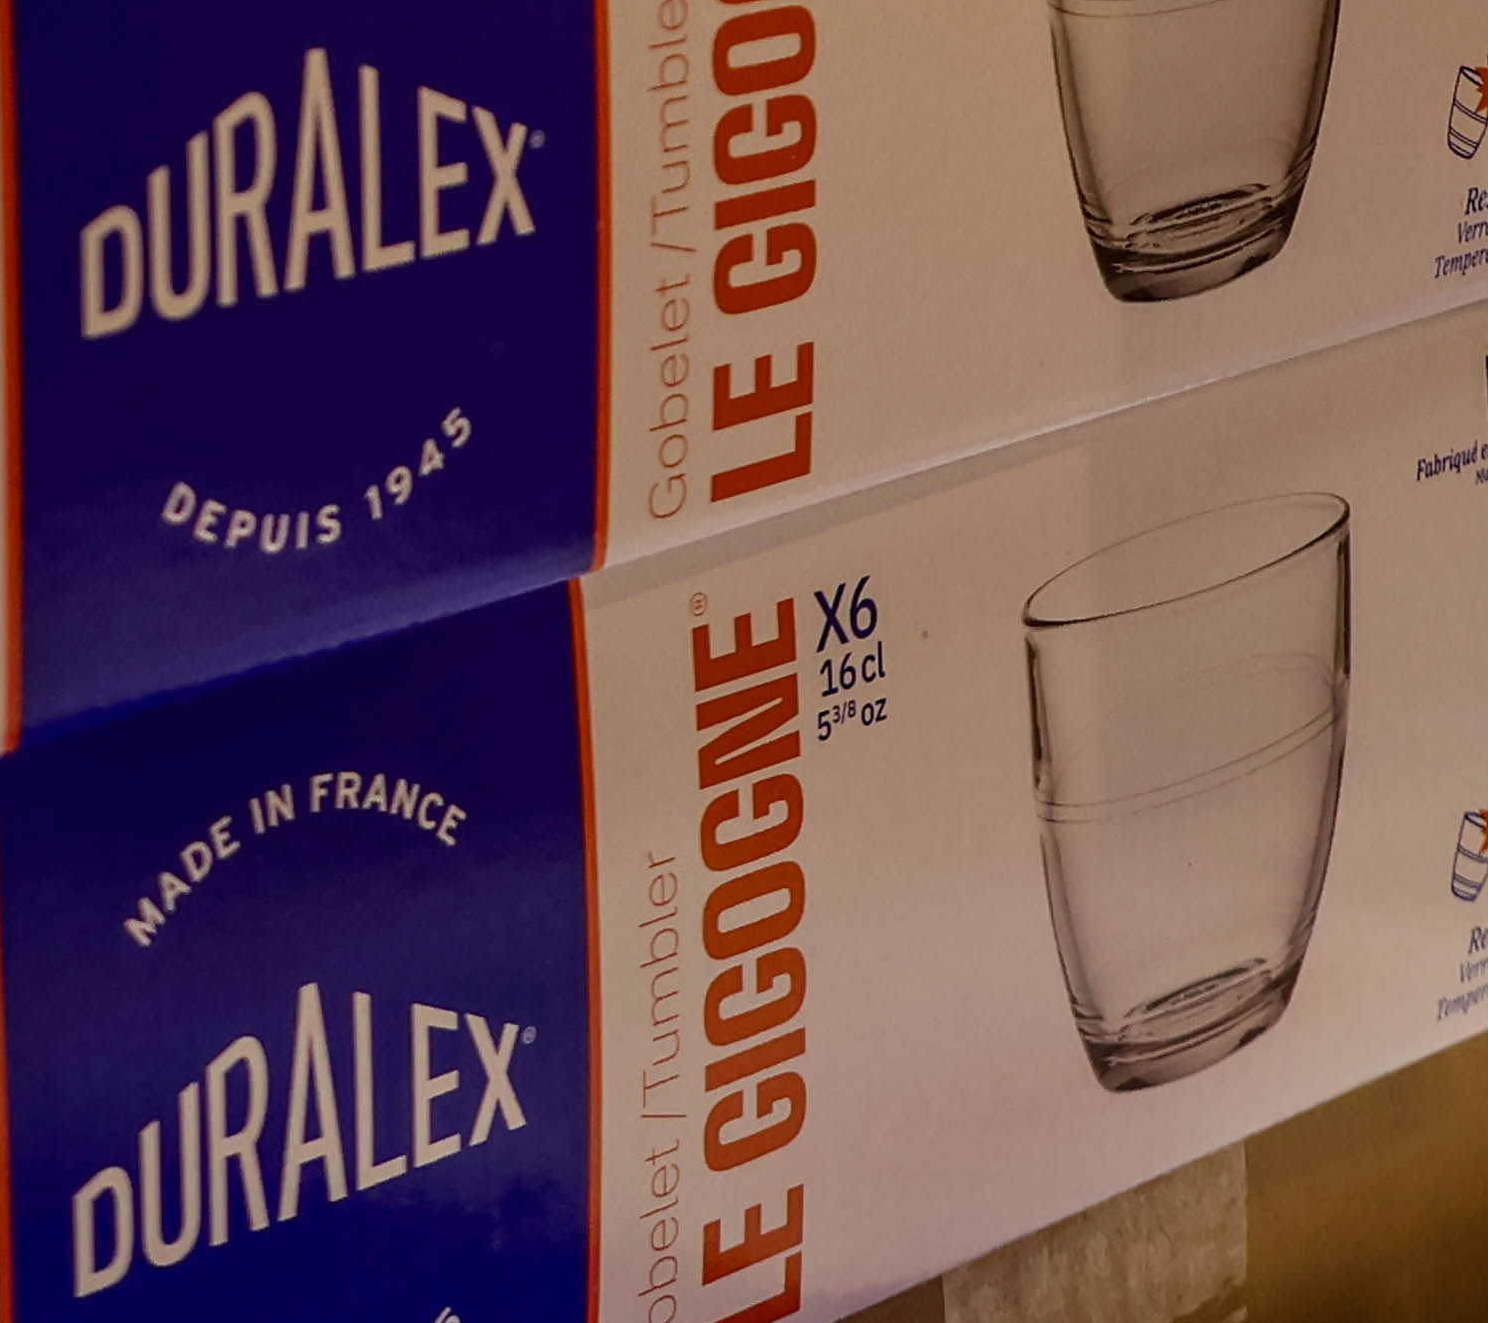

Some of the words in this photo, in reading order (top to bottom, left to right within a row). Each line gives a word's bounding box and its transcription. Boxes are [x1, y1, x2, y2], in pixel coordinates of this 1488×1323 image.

[161, 482, 342, 553] DEPUIS
[363, 406, 472, 521] 1945
[710, 341, 815, 503] LE
[813, 575, 879, 653] X6
[123, 815, 241, 947] MADE
[249, 783, 295, 835] IN
[309, 771, 467, 847] FRANCE
[702, 1183, 805, 1323] LE
